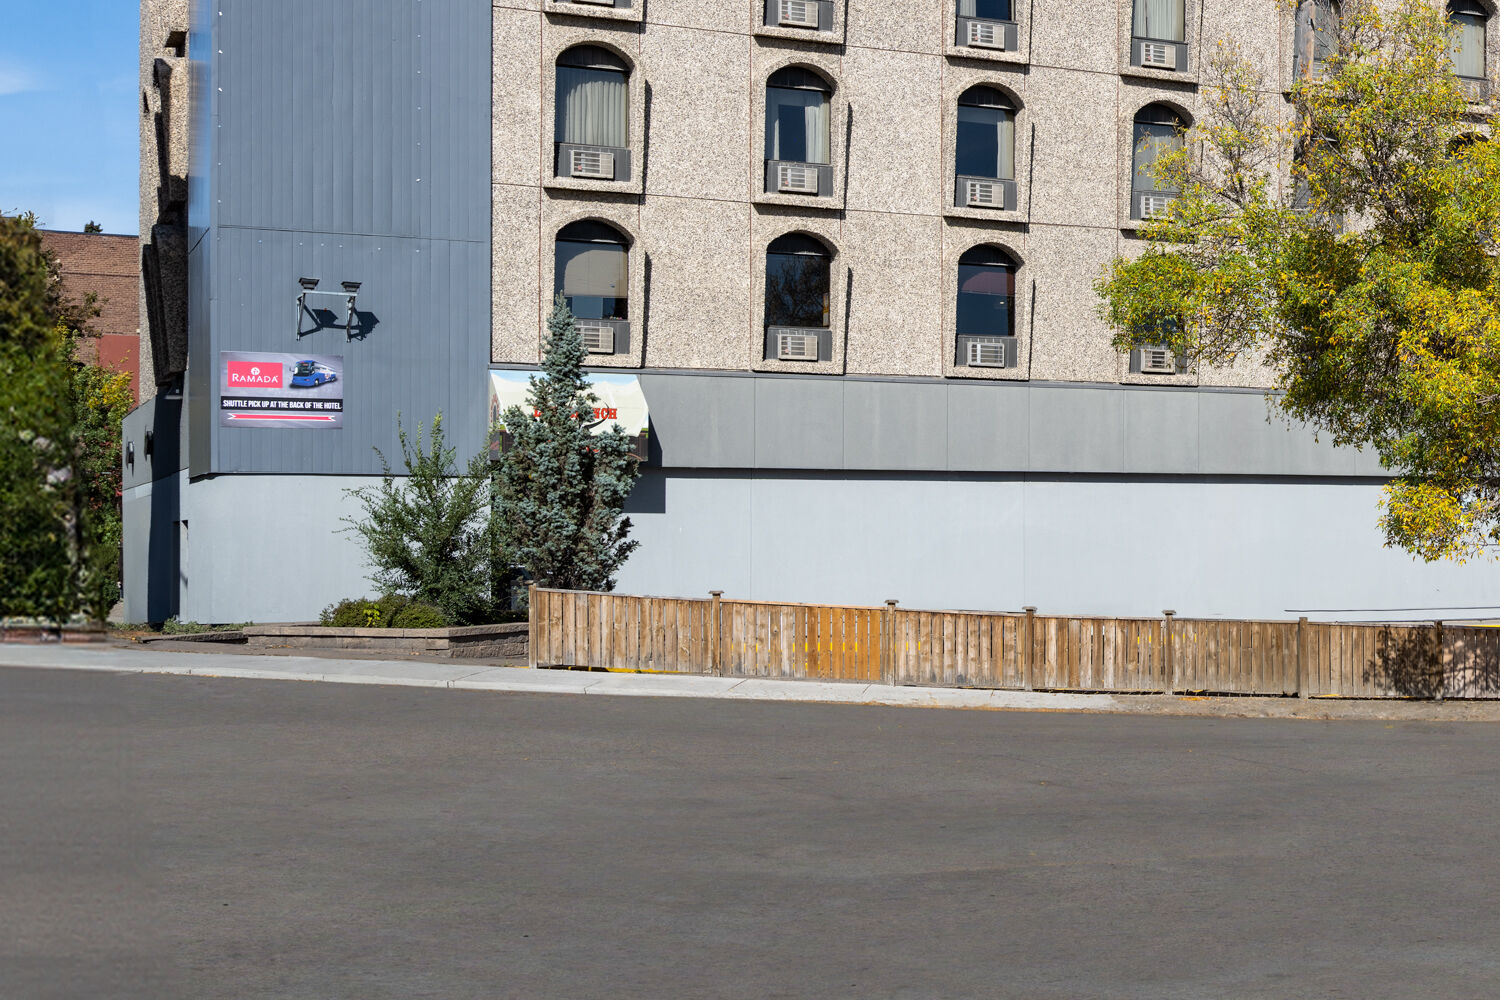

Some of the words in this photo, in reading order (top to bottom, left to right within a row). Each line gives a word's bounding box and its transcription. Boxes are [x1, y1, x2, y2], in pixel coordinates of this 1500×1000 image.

[232, 373, 278, 383] RAMADA
[248, 400, 261, 408] PICK
[289, 401, 304, 409] BACK
